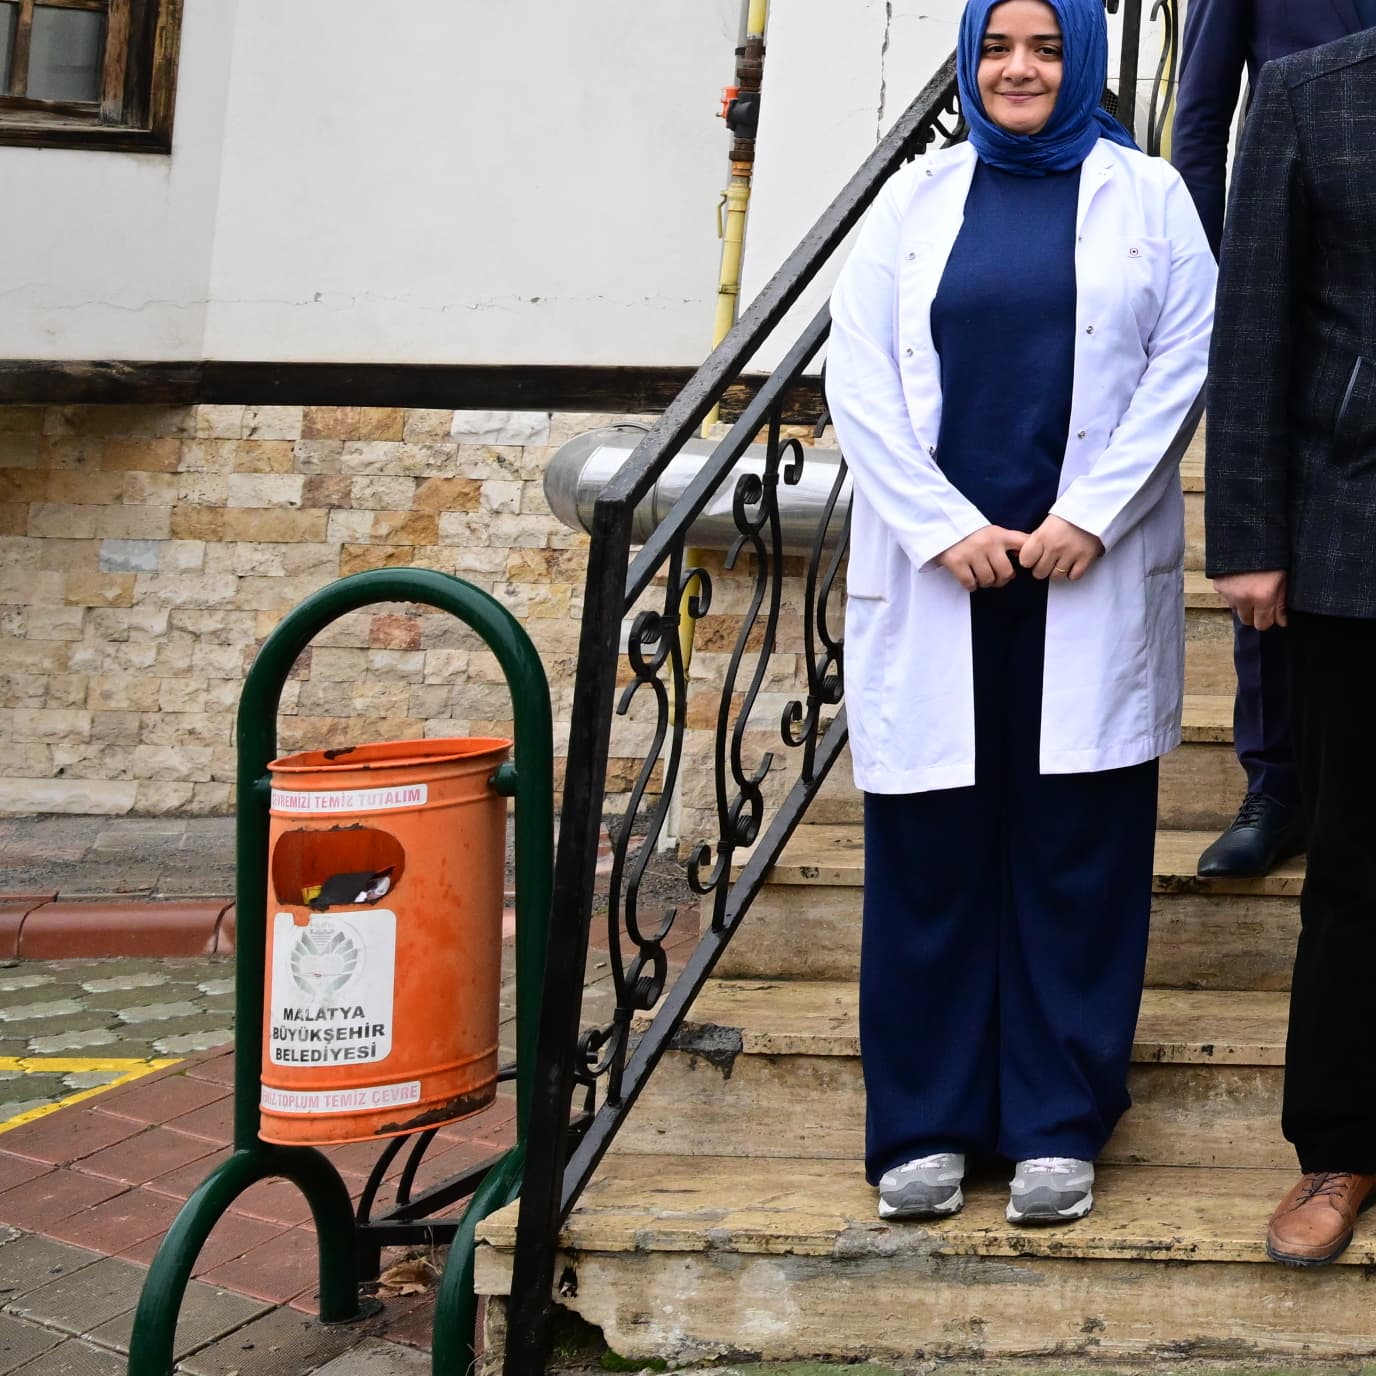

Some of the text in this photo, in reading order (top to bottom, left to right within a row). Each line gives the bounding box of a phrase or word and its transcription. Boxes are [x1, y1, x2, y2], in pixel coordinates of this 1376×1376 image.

[315, 793, 352, 808] TEMİZ
[358, 789, 421, 805] TUTALIM
[283, 1006, 365, 1022] MALATYA
[273, 1022, 385, 1044] BÜYÜKŞEHİR
[275, 1041, 376, 1062] BELEDİYESİ
[277, 1093, 320, 1109] TOPLUM
[324, 1090, 367, 1108] TEMİZ
[371, 1085, 418, 1105] ÇEVRE
